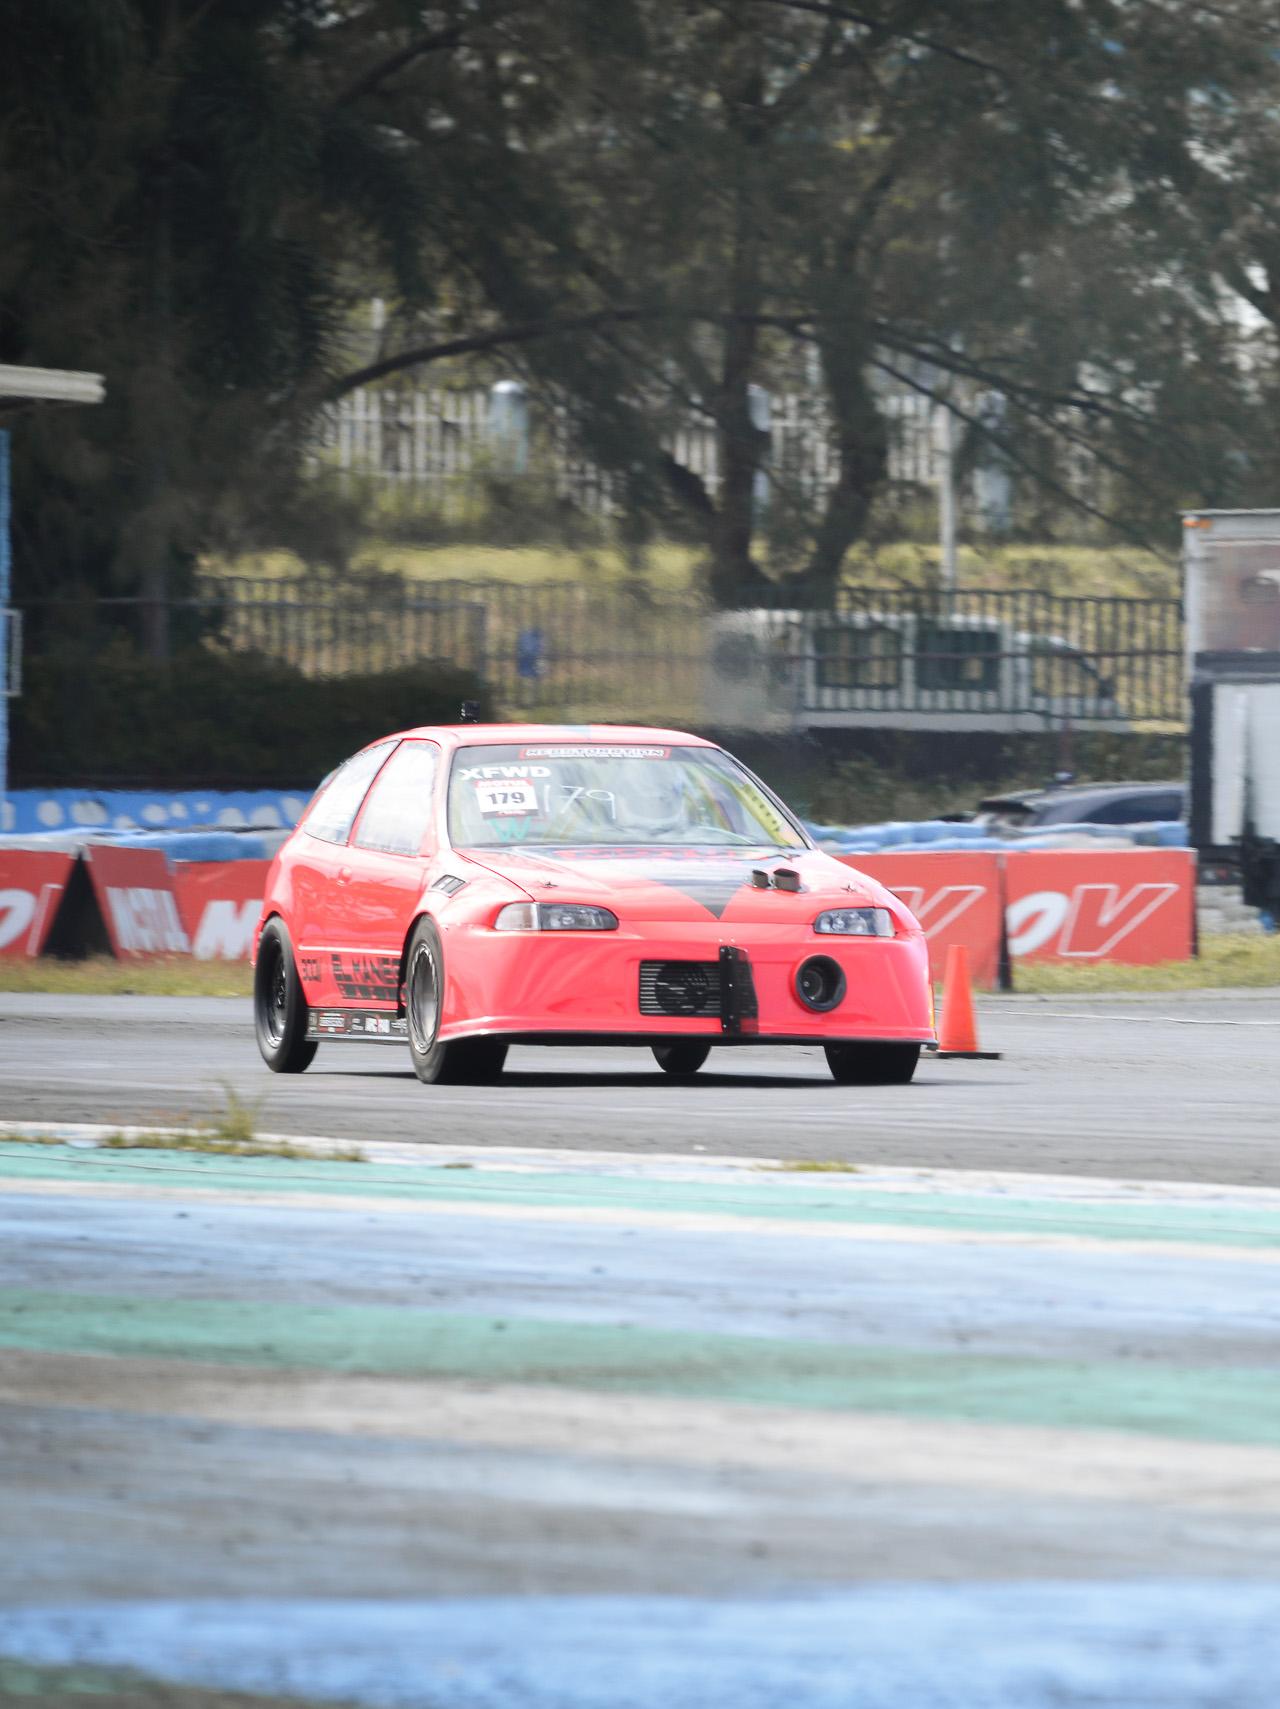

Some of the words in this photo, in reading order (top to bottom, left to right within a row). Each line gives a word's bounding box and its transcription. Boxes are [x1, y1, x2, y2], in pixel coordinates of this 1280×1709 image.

[458, 766, 551, 781] XFWD
[487, 792, 526, 805] 179
[543, 784, 617, 820] 179
